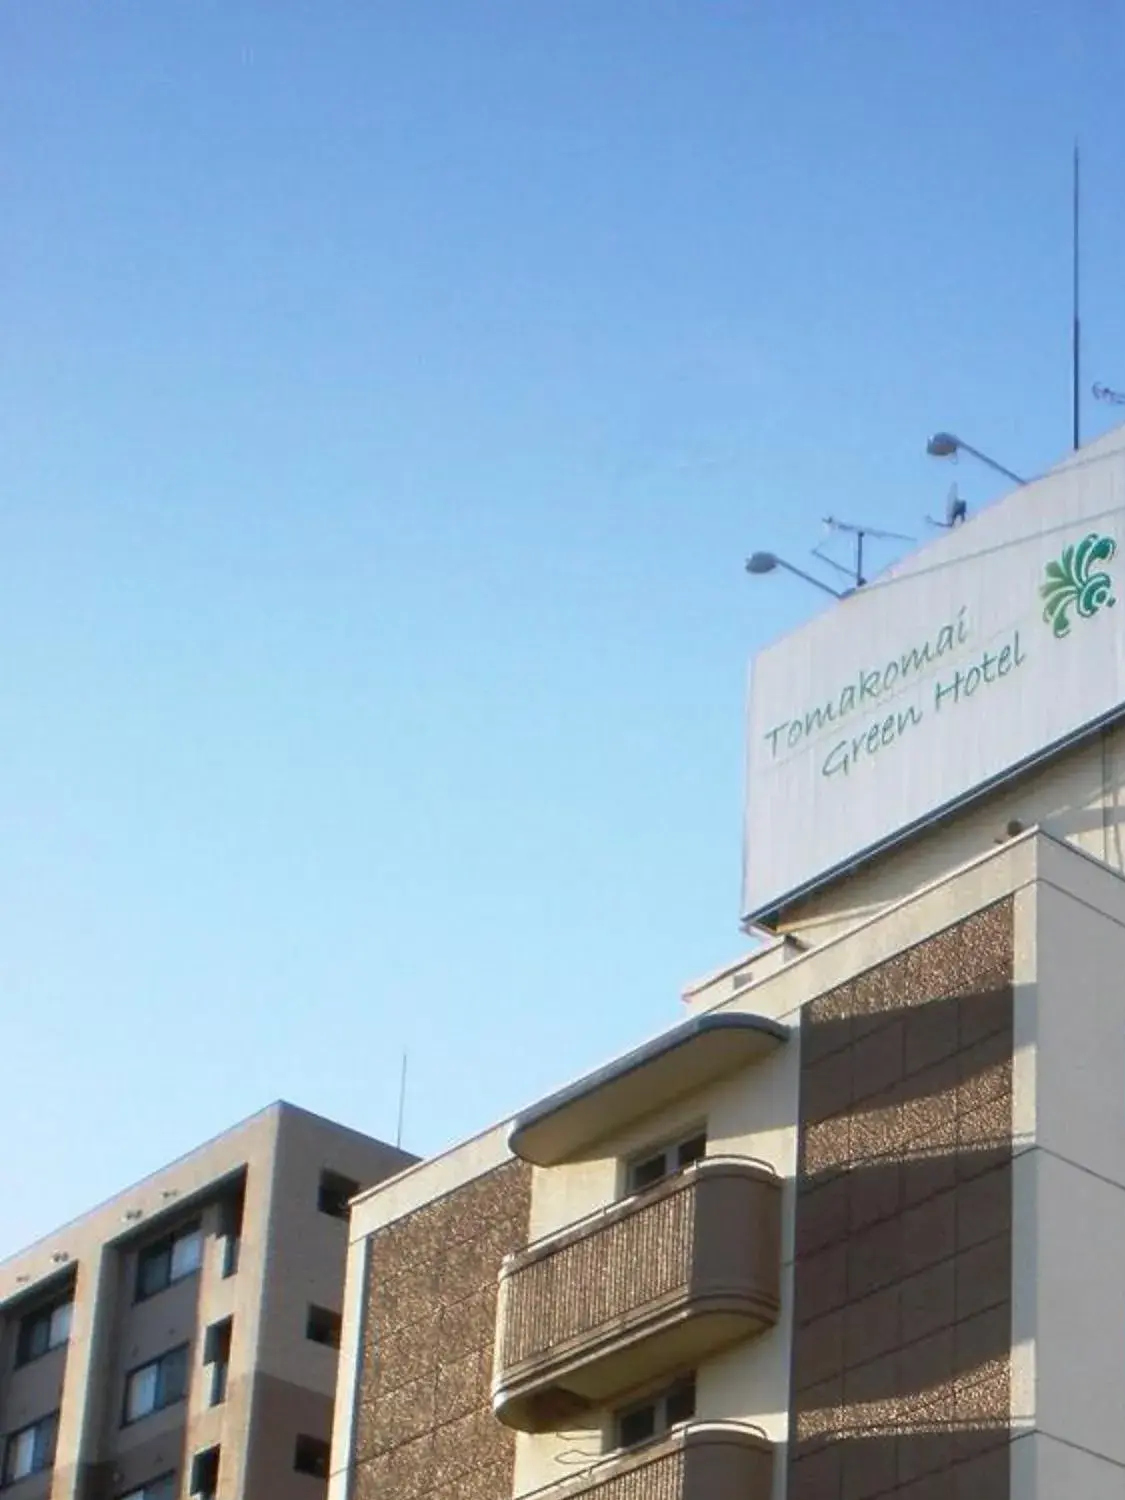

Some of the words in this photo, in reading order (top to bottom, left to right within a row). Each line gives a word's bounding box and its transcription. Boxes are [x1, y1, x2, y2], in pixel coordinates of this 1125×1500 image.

[764, 605, 970, 758] Tomakomai
[822, 705, 923, 779] Green
[934, 630, 1027, 714] Hotel
